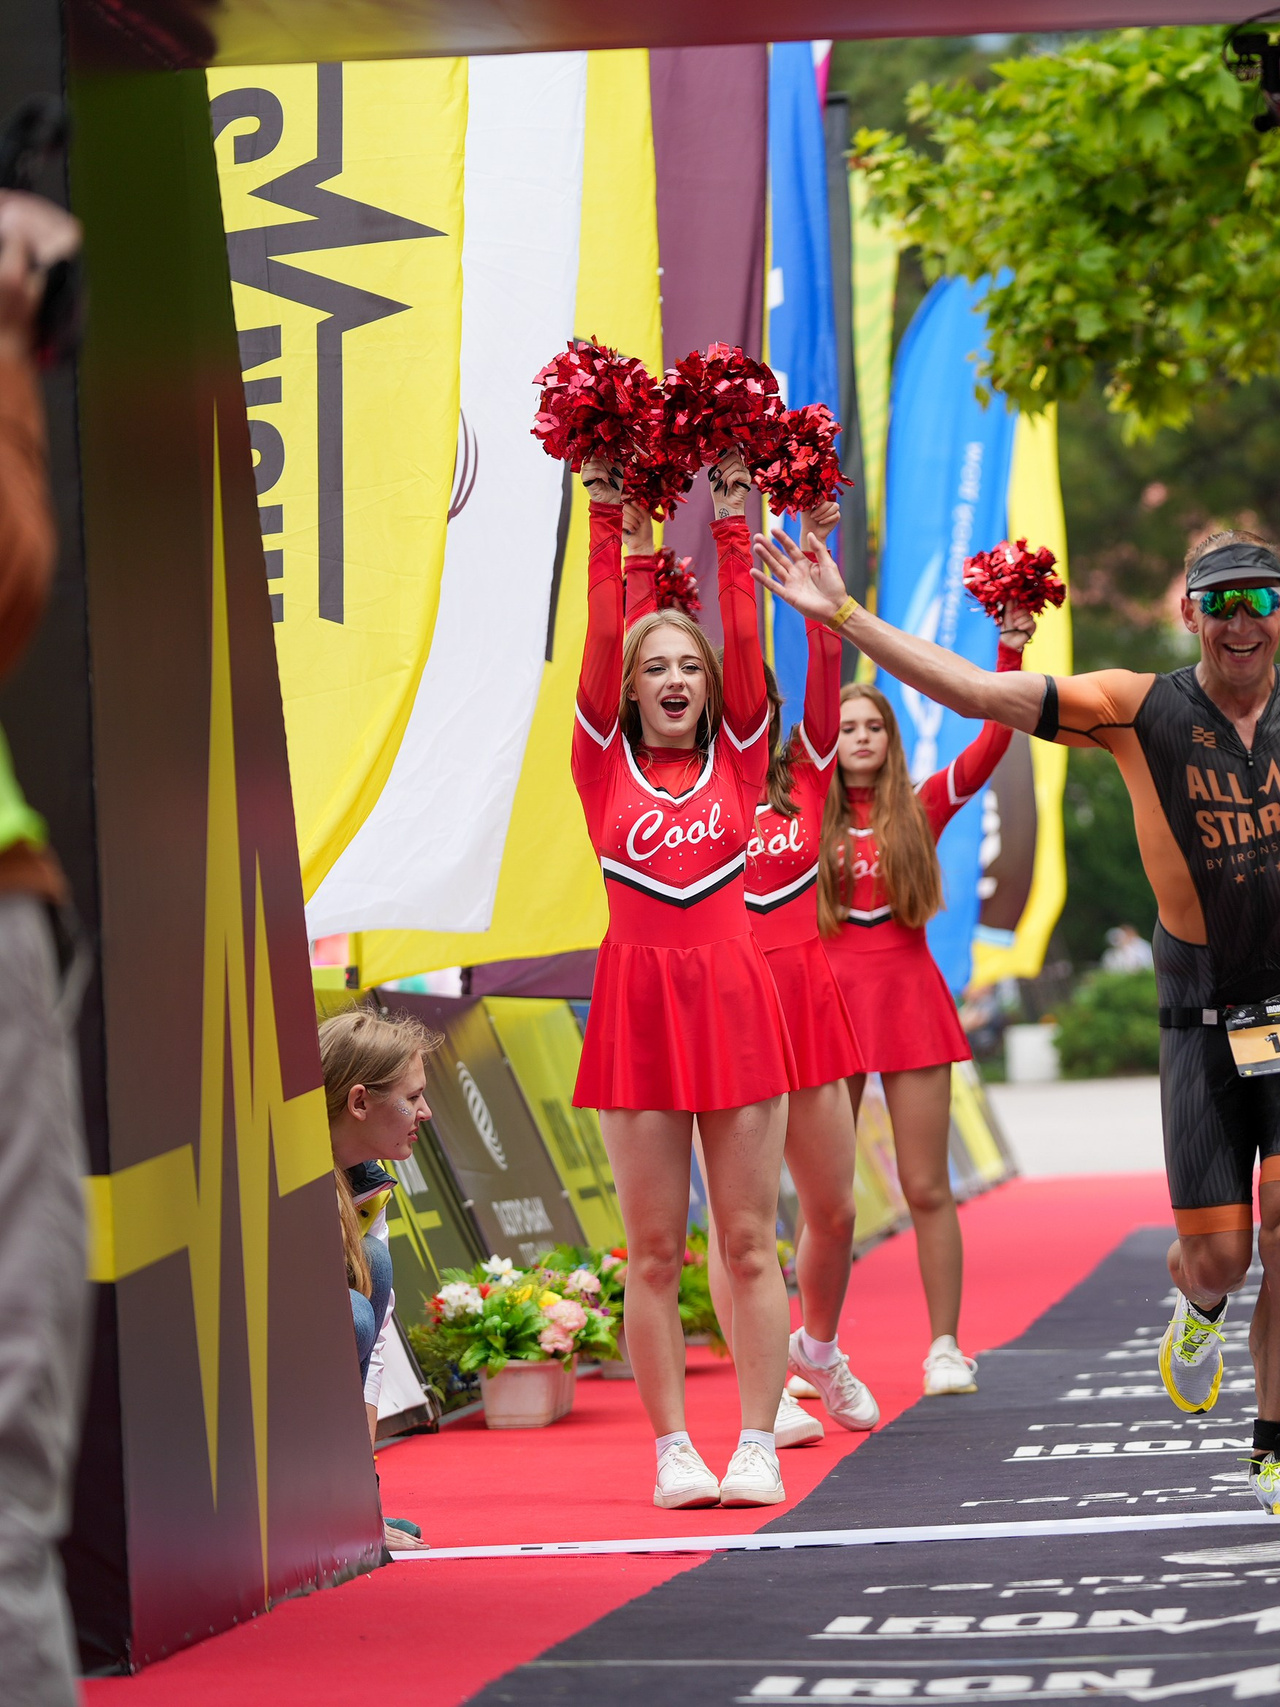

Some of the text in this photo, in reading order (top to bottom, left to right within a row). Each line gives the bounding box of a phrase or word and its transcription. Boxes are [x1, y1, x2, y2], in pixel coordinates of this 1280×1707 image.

[1185, 764, 1253, 805] ALL
[626, 802, 725, 861] Cool
[747, 818, 804, 857] ool
[1206, 857, 1224, 871] BY
[1013, 1437, 1254, 1457] IRON
[823, 1607, 1187, 1634] IRON
[751, 1667, 1154, 1697] IRON
